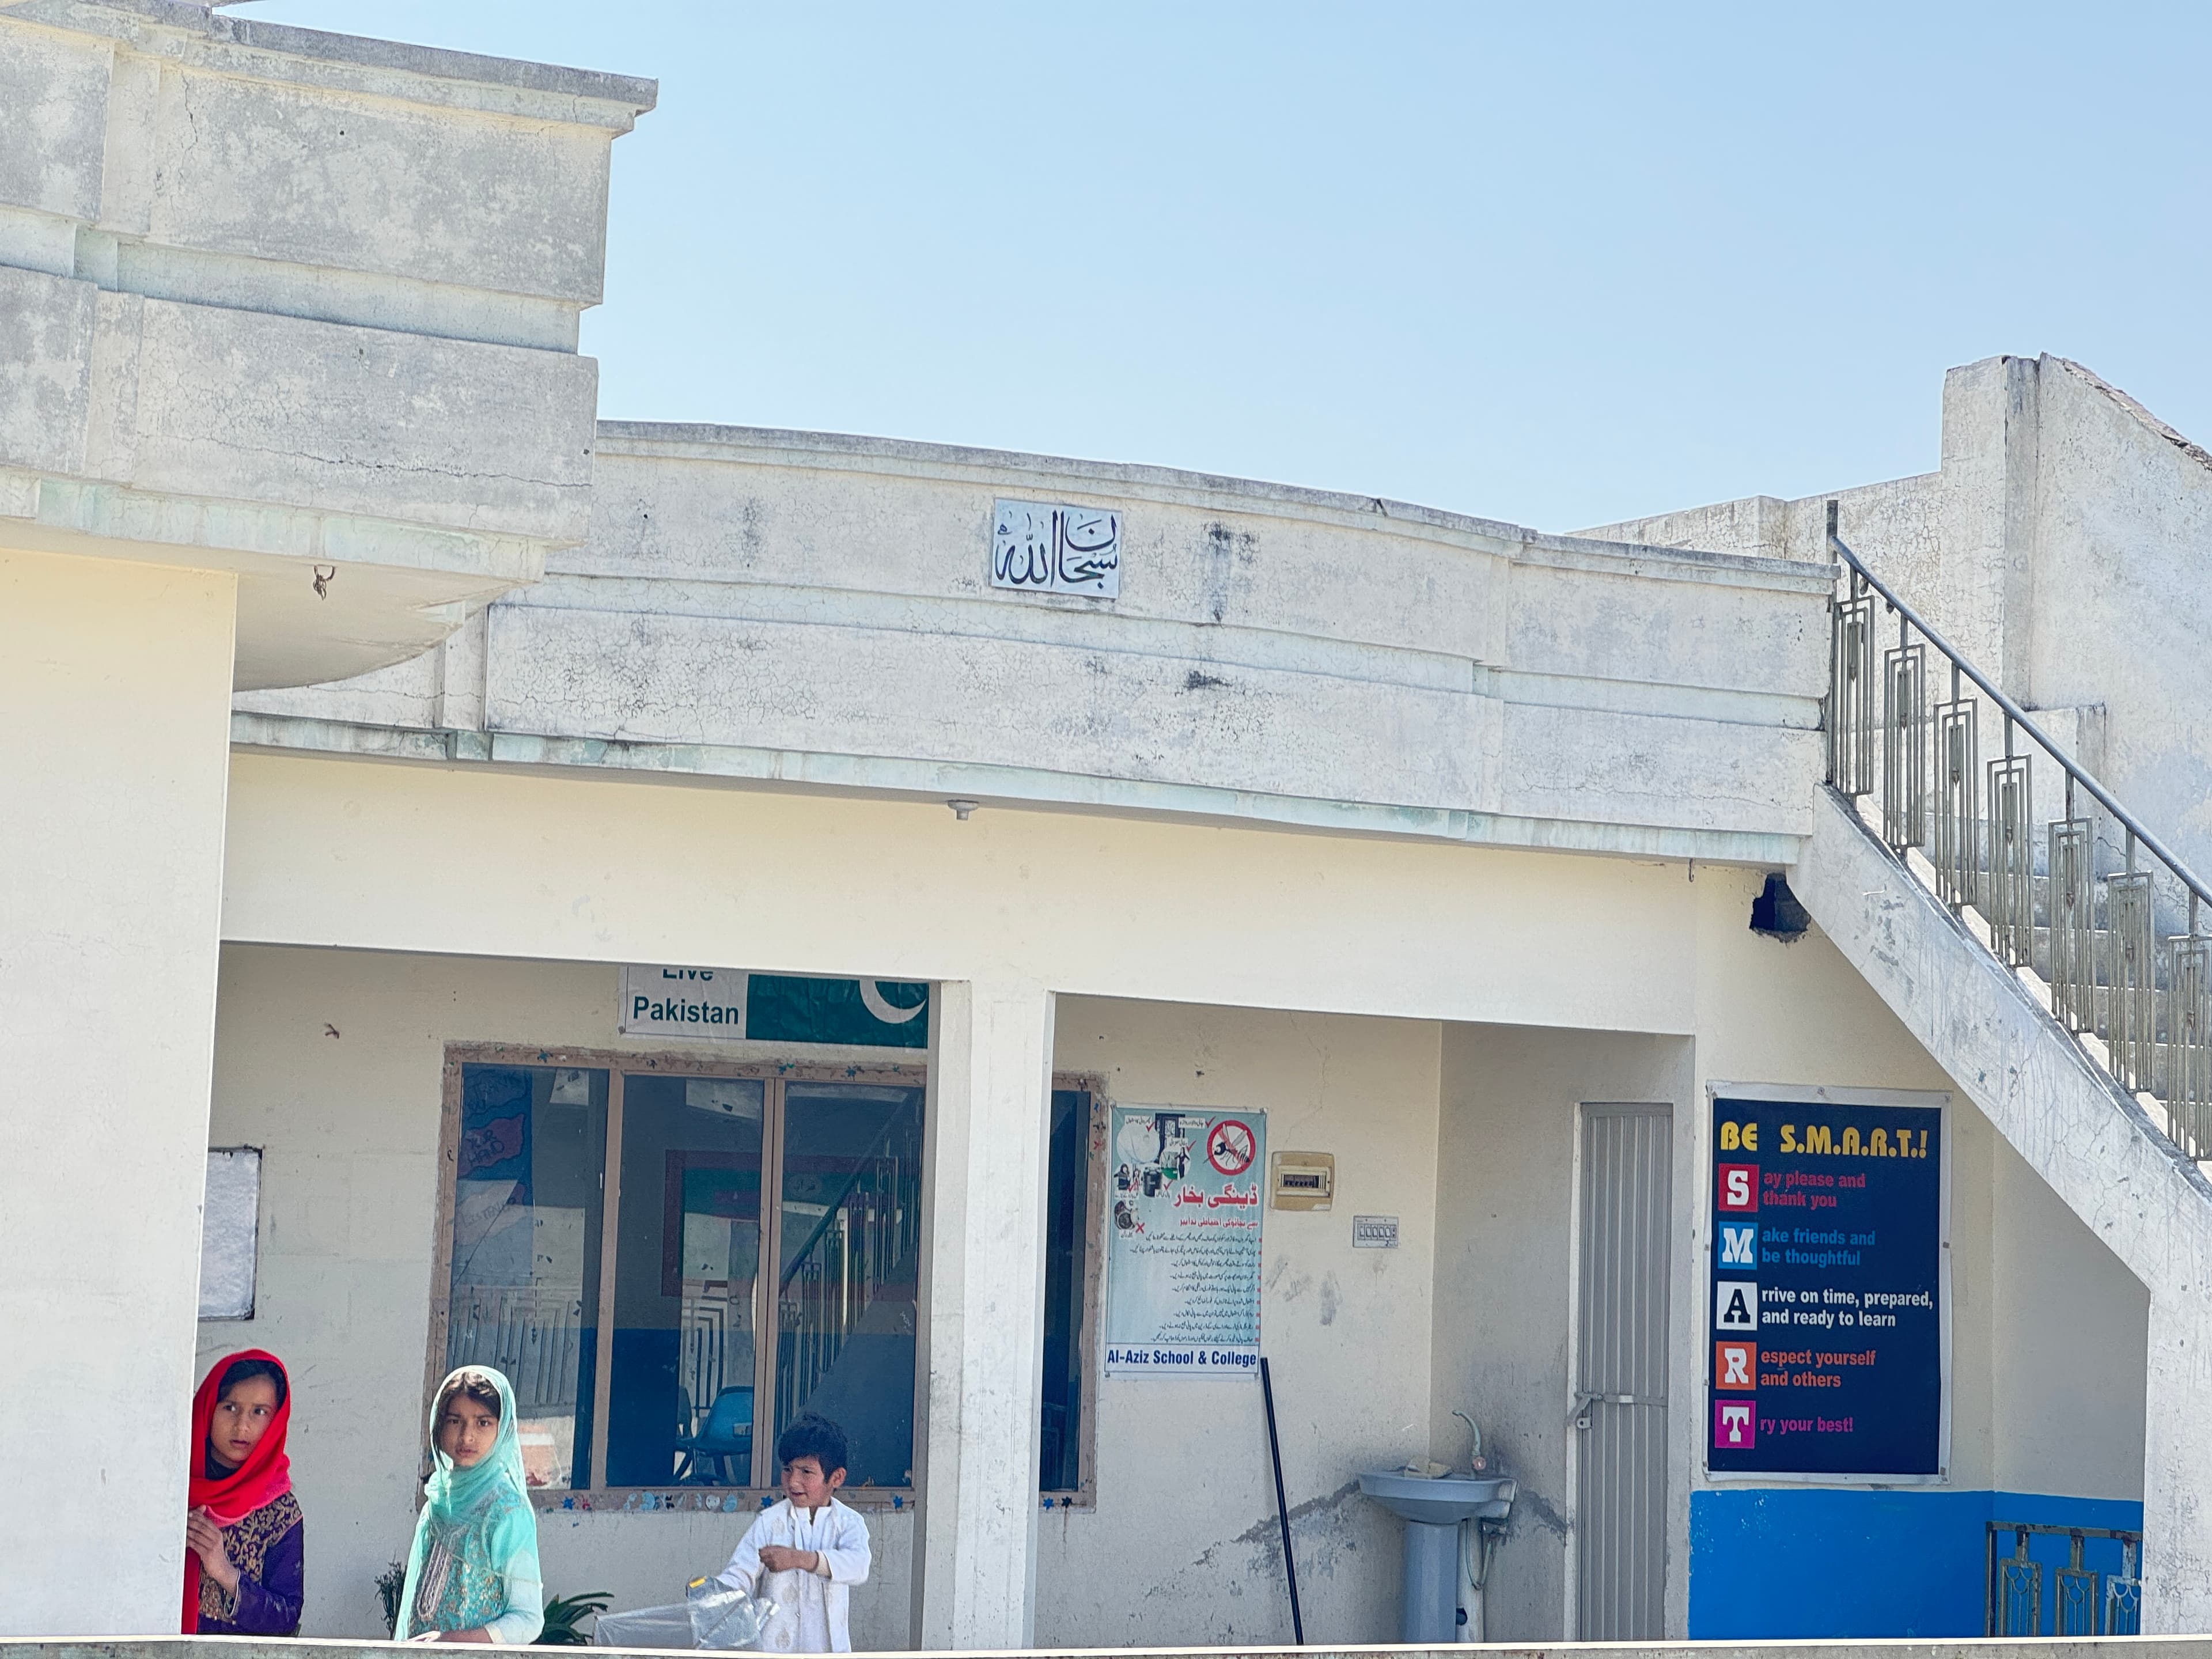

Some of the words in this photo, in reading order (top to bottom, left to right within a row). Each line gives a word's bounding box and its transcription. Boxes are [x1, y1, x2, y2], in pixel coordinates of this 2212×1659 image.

[634, 996, 738, 1024] Pakistan
[1721, 1122, 1757, 1151] BE
[1781, 1124, 1927, 1158] S.M.A.R.T.!
[1173, 1185, 1204, 1208] بخار
[1207, 1183, 1257, 1209] ڈینگی
[1728, 1171, 1749, 1205] S
[1764, 1173, 1782, 1189] ay
[1785, 1171, 1834, 1189] please
[1839, 1173, 1865, 1188] and
[1763, 1190, 1806, 1206] thank
[1810, 1195, 1836, 1210] you
[1722, 1228, 1753, 1263] M
[1763, 1228, 1789, 1242] ake
[1793, 1228, 1845, 1244] friends
[1850, 1231, 1875, 1245] and
[1762, 1249, 1780, 1263] be
[1785, 1249, 1860, 1268] thoughtful
[1724, 1289, 1751, 1324] A
[1762, 1287, 1796, 1302] rrive
[1801, 1291, 1818, 1303] on
[1823, 1289, 1859, 1308] time,
[1865, 1291, 1933, 1309] prepared,
[1762, 1309, 1789, 1324] and
[1794, 1310, 1834, 1328] ready
[1839, 1311, 1853, 1325] to
[1859, 1311, 1895, 1326] learn
[1108, 1350, 1149, 1363] Al-Aziz
[1153, 1350, 1193, 1364] School
[1198, 1351, 1206, 1365] &
[1212, 1351, 1256, 1368] College
[1725, 1349, 1748, 1383] R
[1761, 1350, 1811, 1369] espect
[1816, 1350, 1876, 1368] yourself
[1761, 1371, 1788, 1386] and
[1793, 1372, 1840, 1387] others
[1723, 1407, 1749, 1442] T
[1760, 1419, 1775, 1434] ry
[1780, 1419, 1813, 1434] your
[1817, 1416, 1853, 1432] best!
